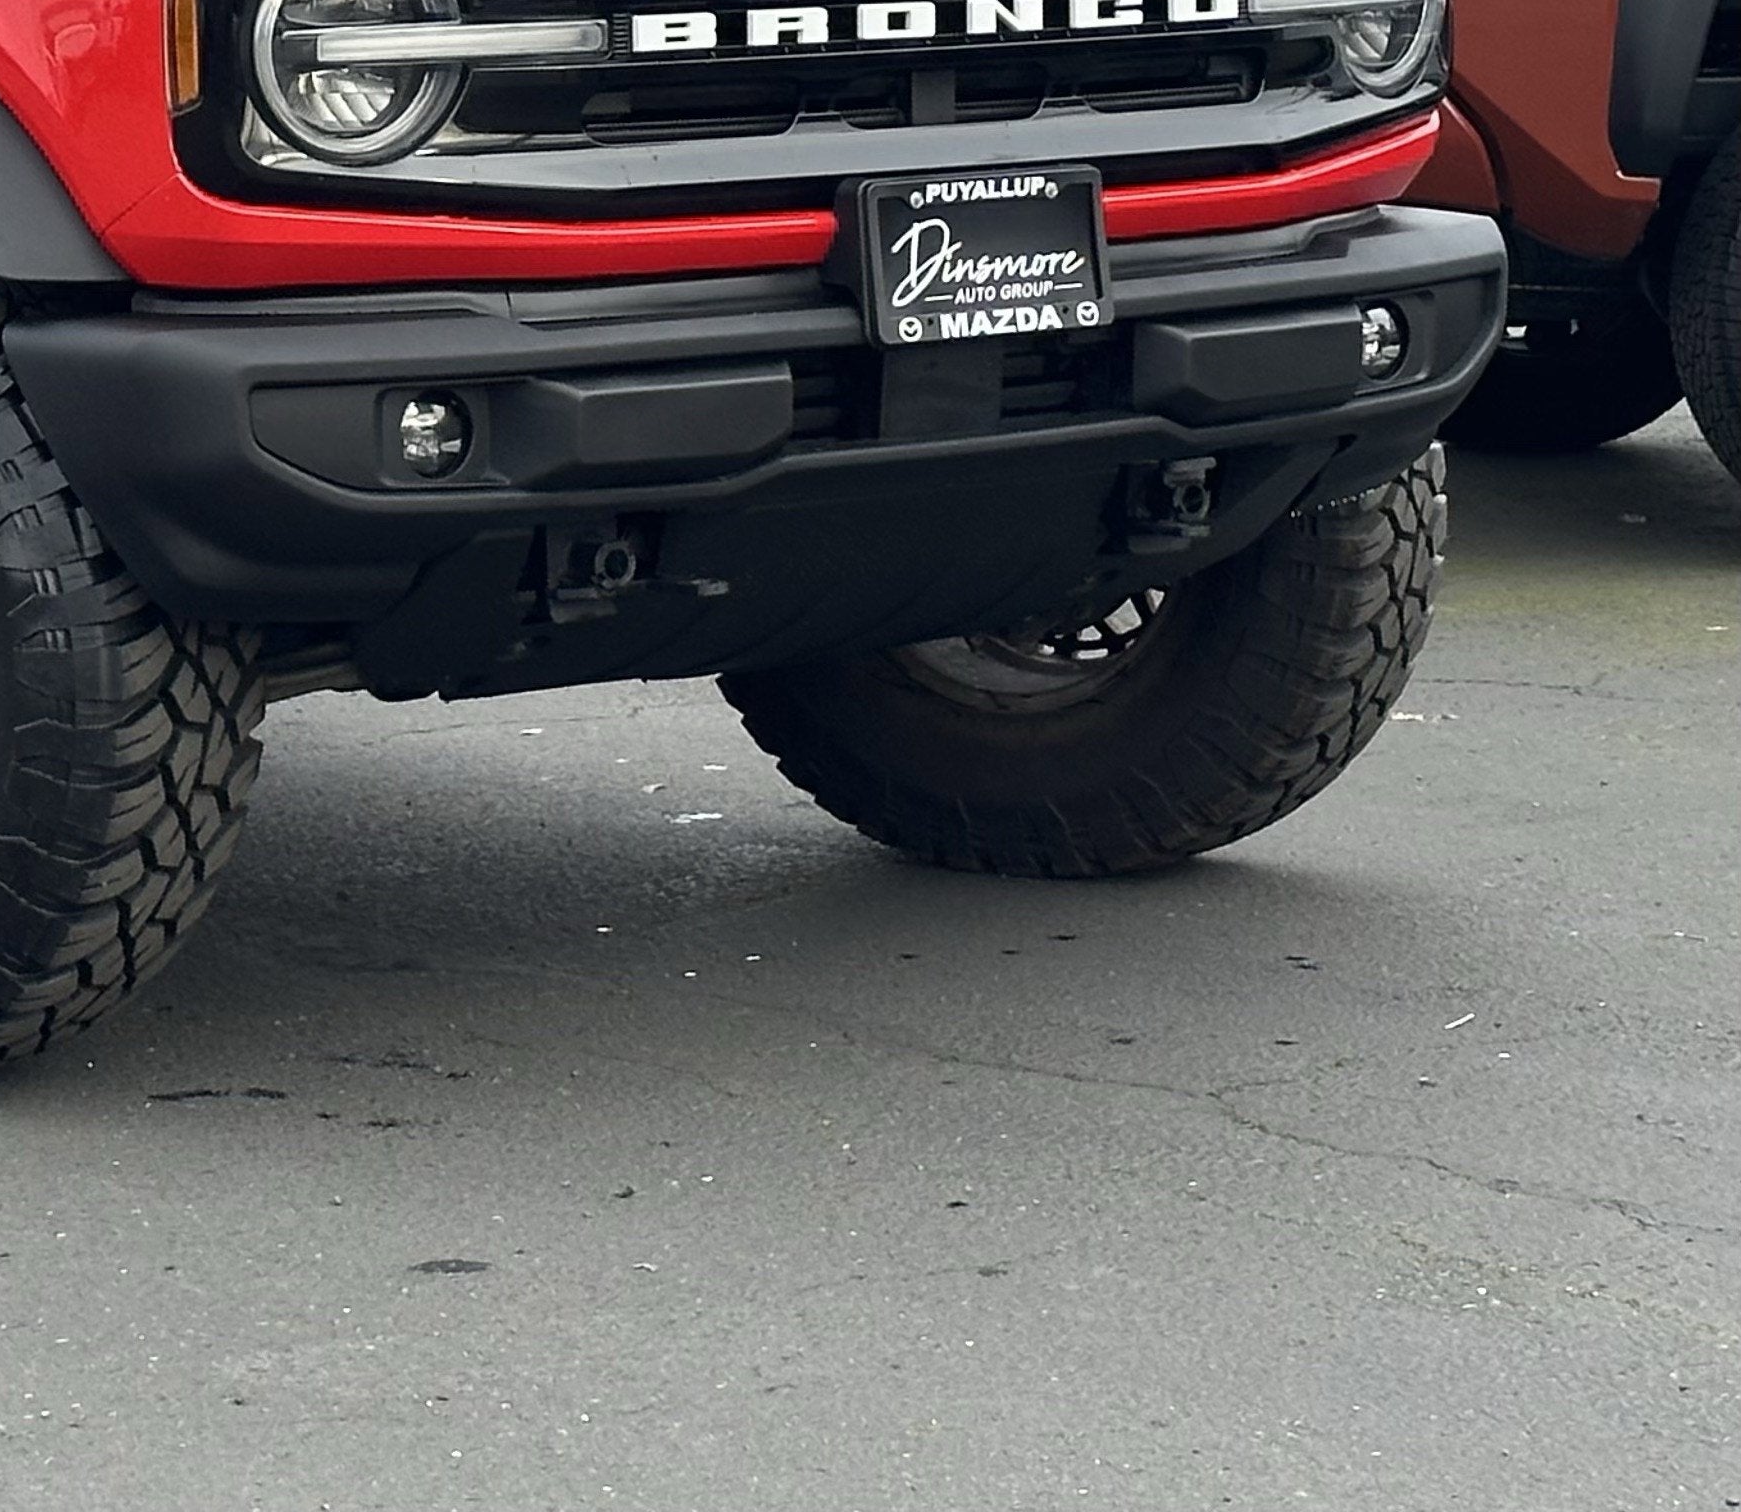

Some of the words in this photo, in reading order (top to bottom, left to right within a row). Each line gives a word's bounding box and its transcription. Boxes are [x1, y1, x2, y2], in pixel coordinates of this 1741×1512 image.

[925, 176, 1046, 203] PUYALLUP
[891, 218, 1085, 307] Dinsmore
[954, 286, 995, 304] AUTO
[1000, 281, 1055, 300] GROUP
[940, 305, 1063, 338] MAZDA
